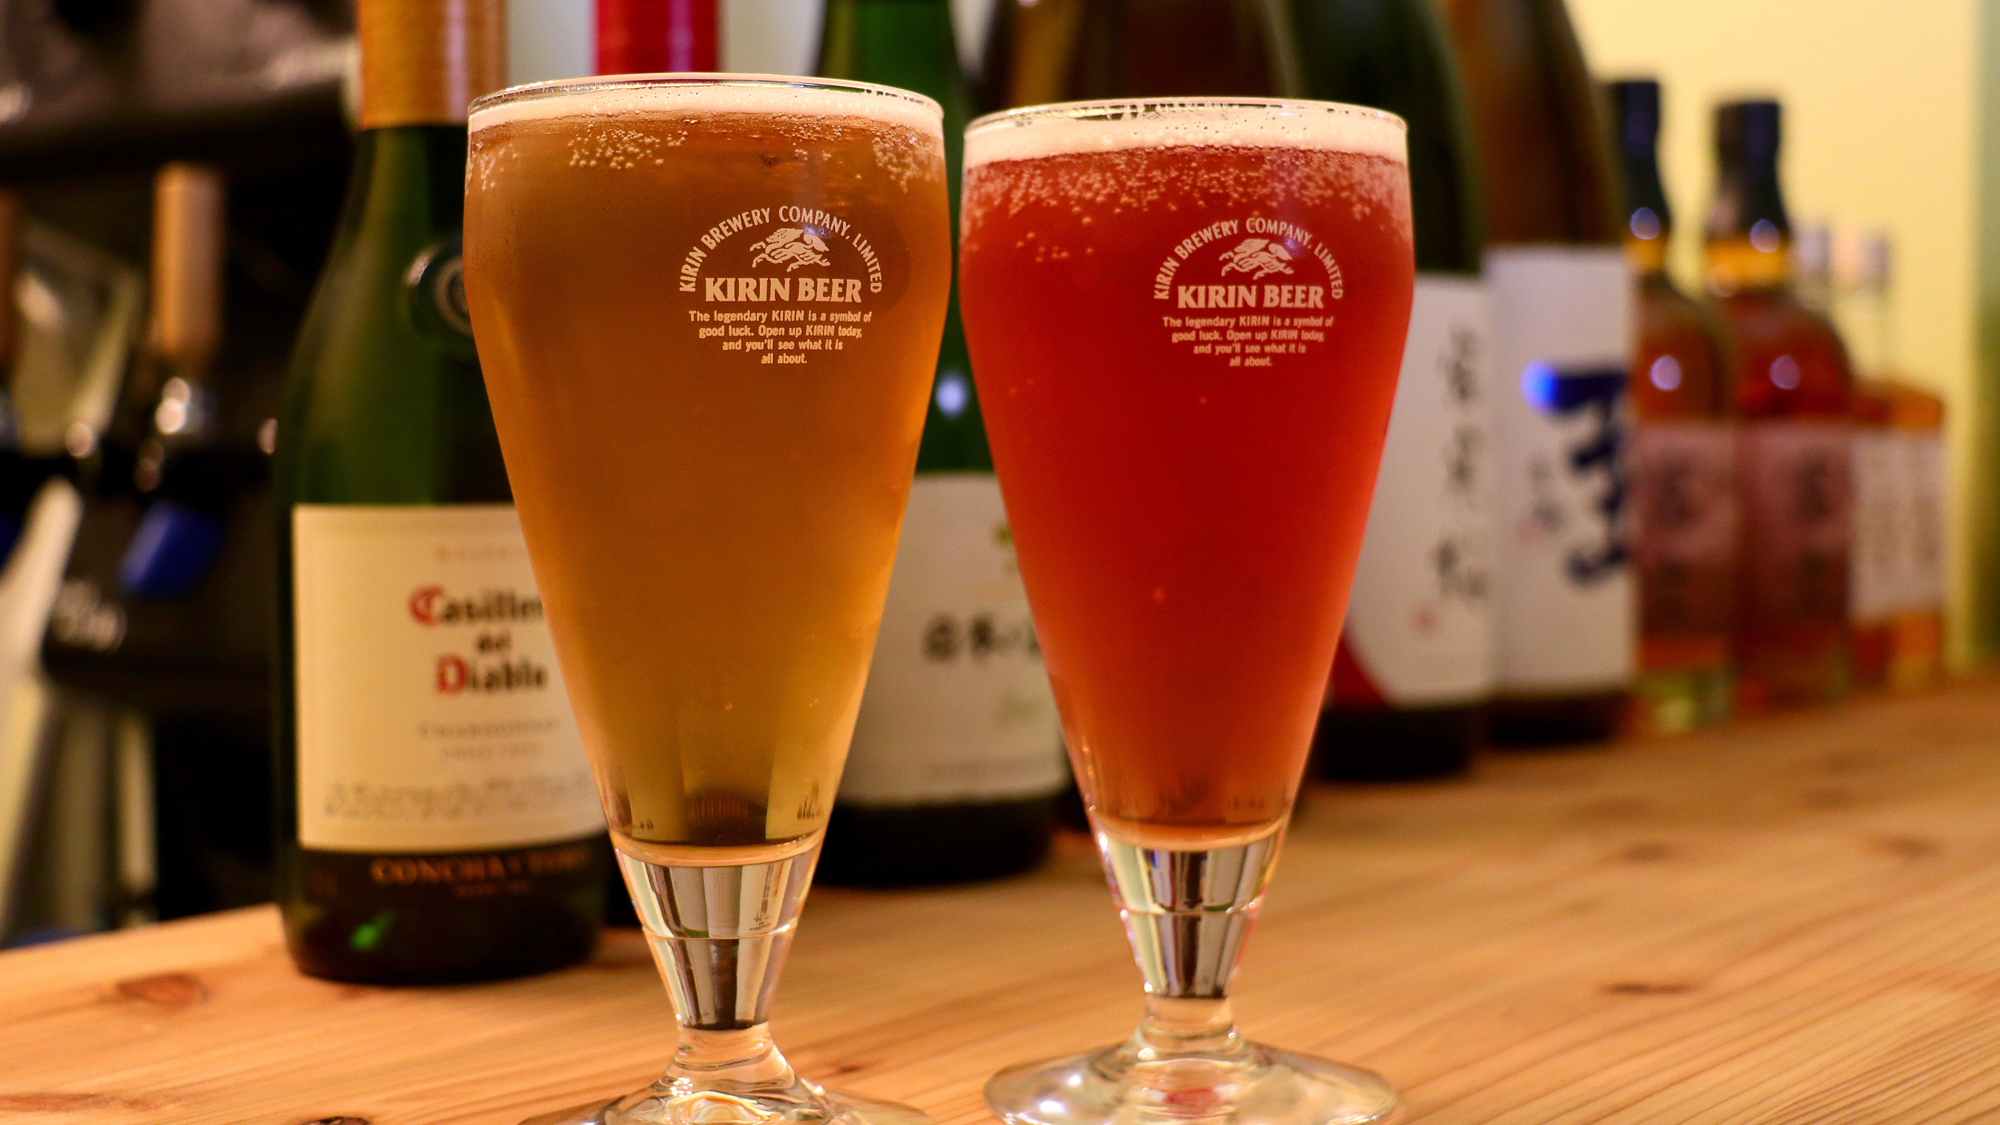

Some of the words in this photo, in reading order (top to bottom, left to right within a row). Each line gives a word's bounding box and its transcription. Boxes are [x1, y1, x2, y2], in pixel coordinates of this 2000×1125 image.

[679, 246, 707, 293] KIRIN
[700, 207, 771, 250] BREWERY
[778, 205, 851, 240] COMPANY,
[852, 233, 883, 294] LIMITED
[1153, 256, 1180, 300] KIRIN
[1174, 219, 1239, 261] BREWERY
[1314, 242, 1344, 300] LIMITED
[705, 277, 791, 302] KIRIN
[797, 278, 862, 303] BEER
[1177, 285, 1257, 309] KIRIN
[1262, 284, 1324, 309] BEER
[688, 310, 711, 322] The
[714, 310, 768, 324] legendary
[771, 310, 804, 321] KIRIN
[808, 310, 817, 321] is
[820, 313, 826, 321] a
[829, 311, 861, 323] symbol
[863, 311, 872, 322] of
[1162, 316, 1182, 328] The
[1185, 315, 1236, 329] legendary
[1239, 315, 1270, 327] KIRIN
[1273, 316, 1281, 327] is
[1284, 318, 1290, 327] a
[1293, 316, 1323, 328] symbol
[1325, 316, 1334, 327] of
[698, 325, 725, 338] good
[728, 325, 754, 336] luck.
[758, 325, 785, 338] Open
[789, 327, 802, 338] up
[805, 325, 835, 336] KIRIN
[838, 325, 862, 339] today,
[1171, 330, 1196, 344] good
[1199, 330, 1223, 341] luck.
[1226, 329, 1252, 343] Open
[1255, 331, 1268, 342] up
[1270, 329, 1298, 340] KIRIN
[722, 340, 742, 350] and
[745, 339, 774, 352] you'll
[778, 341, 795, 350] see
[798, 340, 822, 350] what
[825, 340, 832, 350] it
[835, 340, 843, 350] is
[1193, 343, 1212, 354] and
[1244, 345, 1261, 354] see
[1263, 343, 1286, 354] what
[1288, 343, 1296, 354] it
[1298, 343, 1306, 354] is
[761, 353, 773, 364] all
[777, 354, 808, 364] about.
[1229, 356, 1241, 367] all
[1244, 356, 1273, 367] about.
[408, 584, 545, 626] Casiller
[435, 653, 547, 696] Diablo
